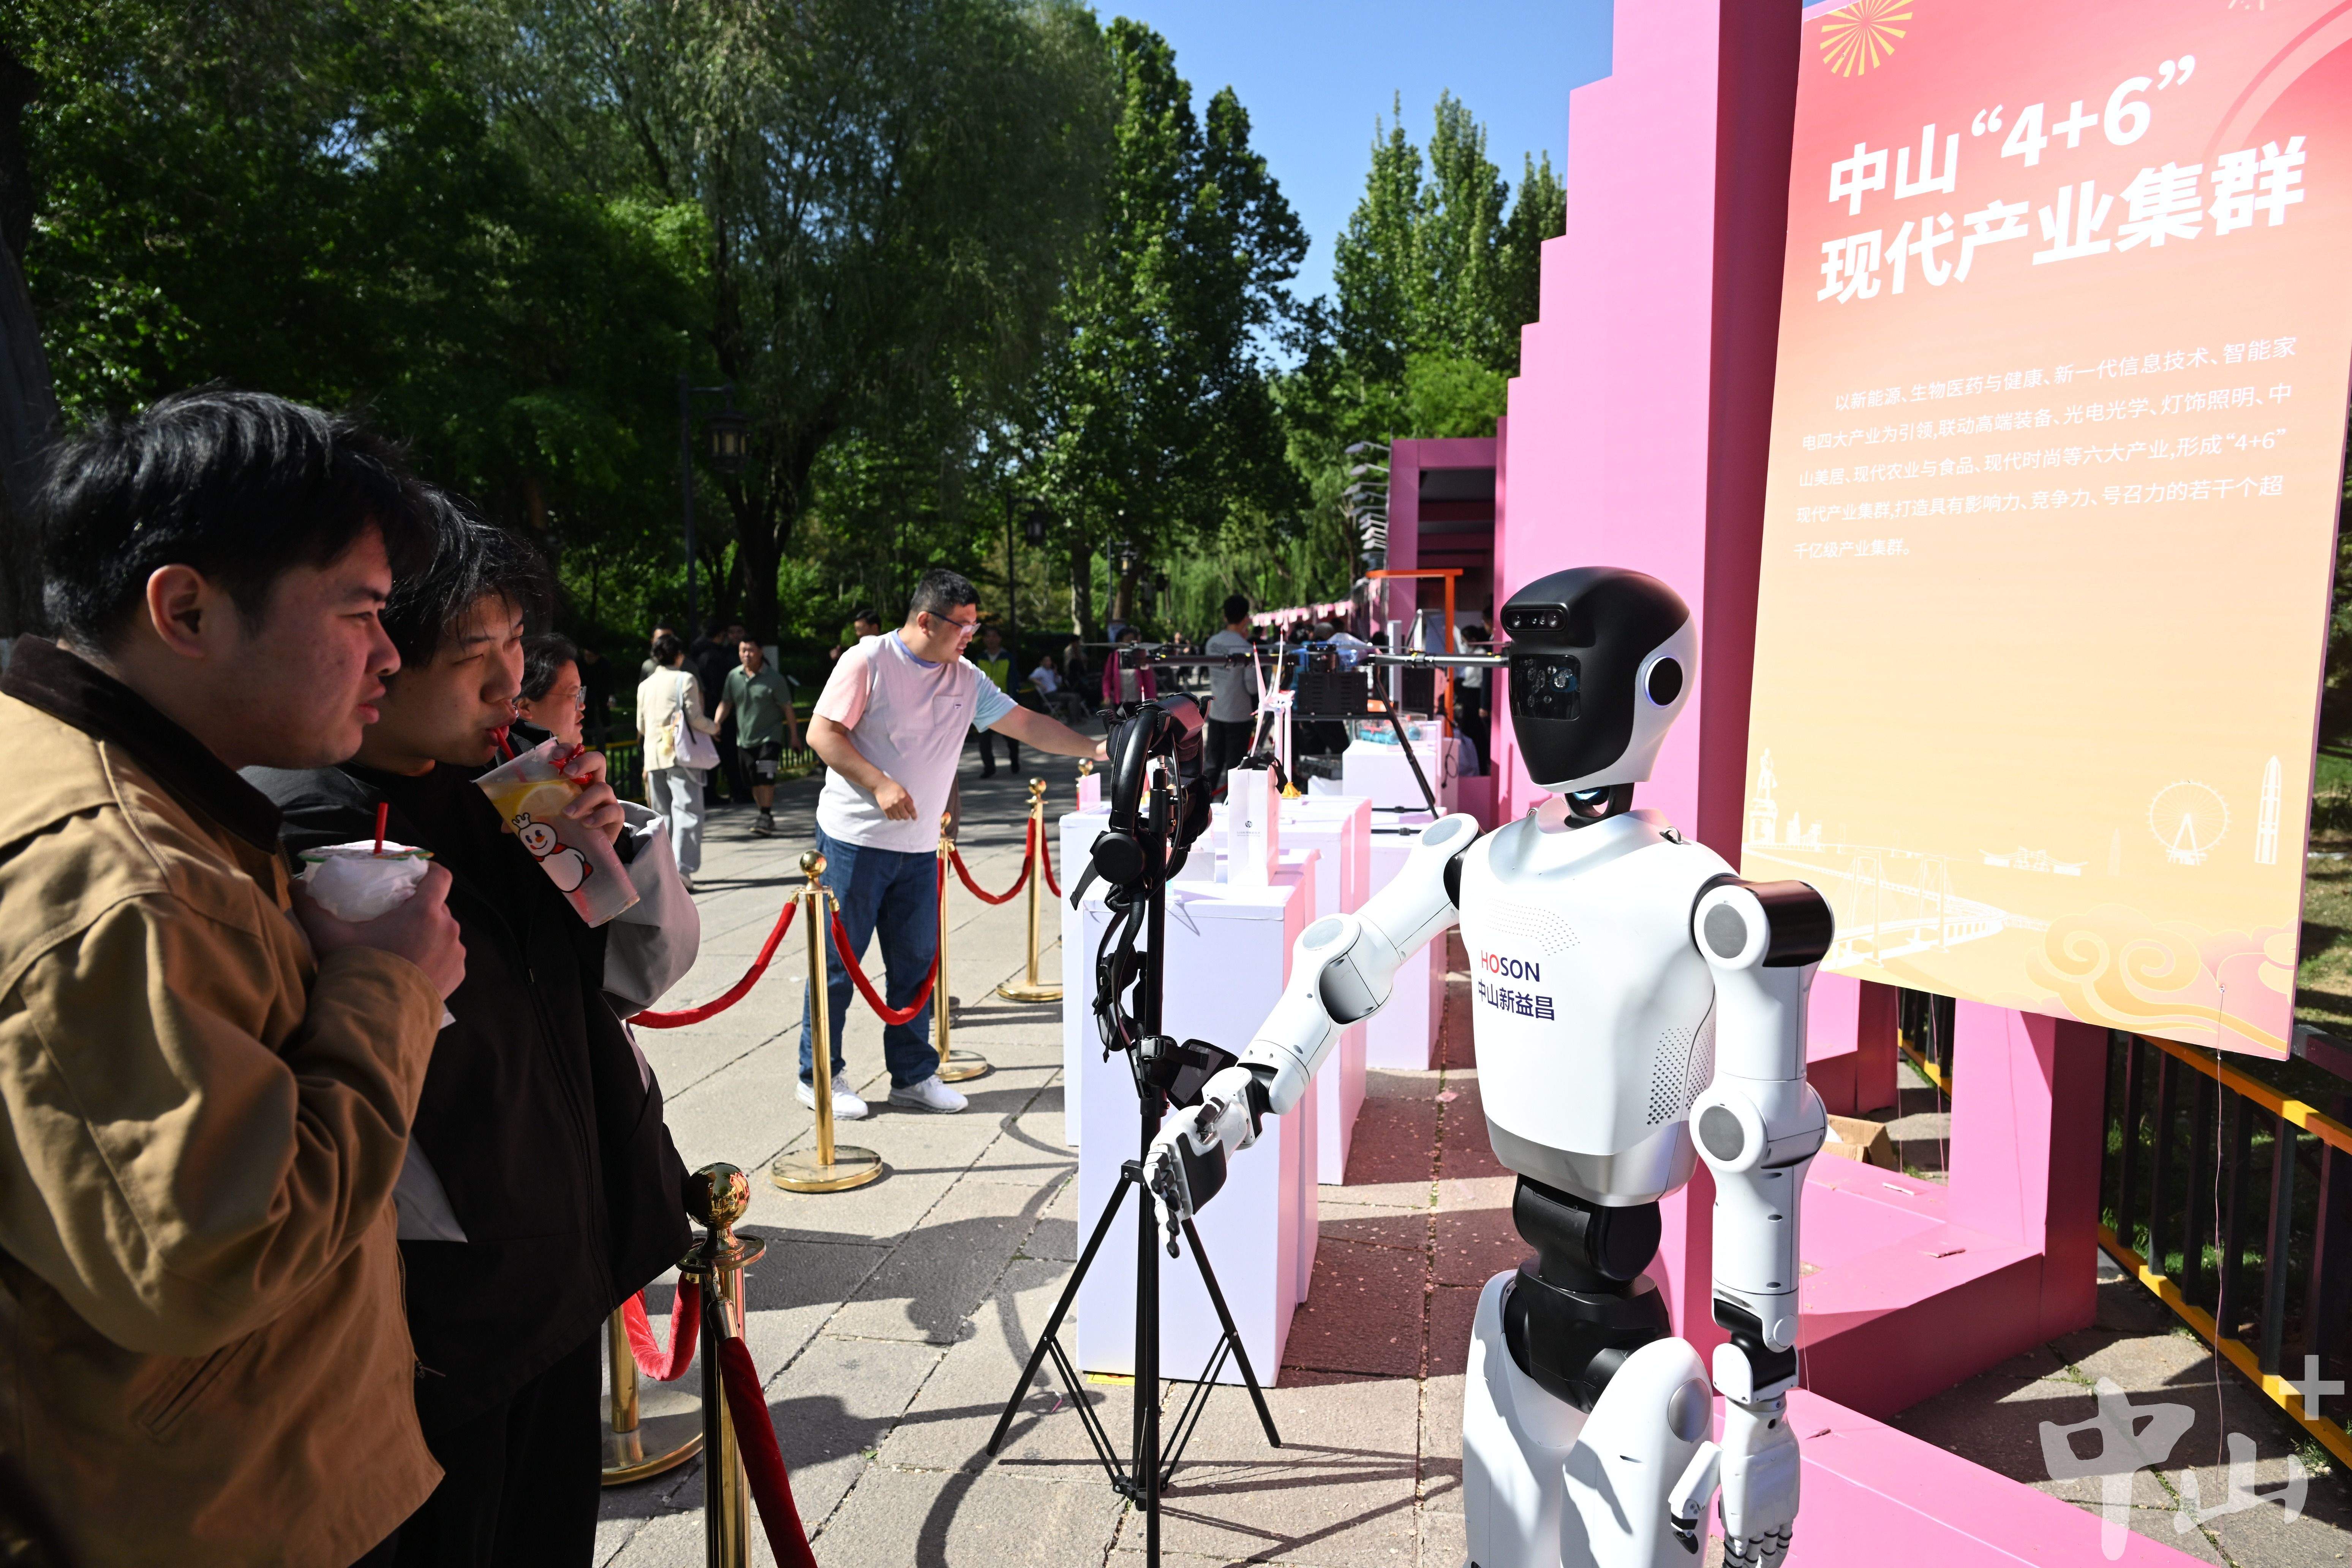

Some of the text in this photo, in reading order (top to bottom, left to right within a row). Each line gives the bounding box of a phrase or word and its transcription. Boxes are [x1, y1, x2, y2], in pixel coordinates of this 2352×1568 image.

[1828, 54, 2196, 217] 中山“4+6”
[1817, 136, 2306, 305] 现代产业集群
[1835, 336, 2297, 411] 以新能源、生物医药与健康、新一代信息技术、智能家
[1793, 537, 1909, 560] 千亿级产业集群。
[1481, 950, 1540, 982] HOSON
[1478, 978, 1555, 1021] 中山新益昌
